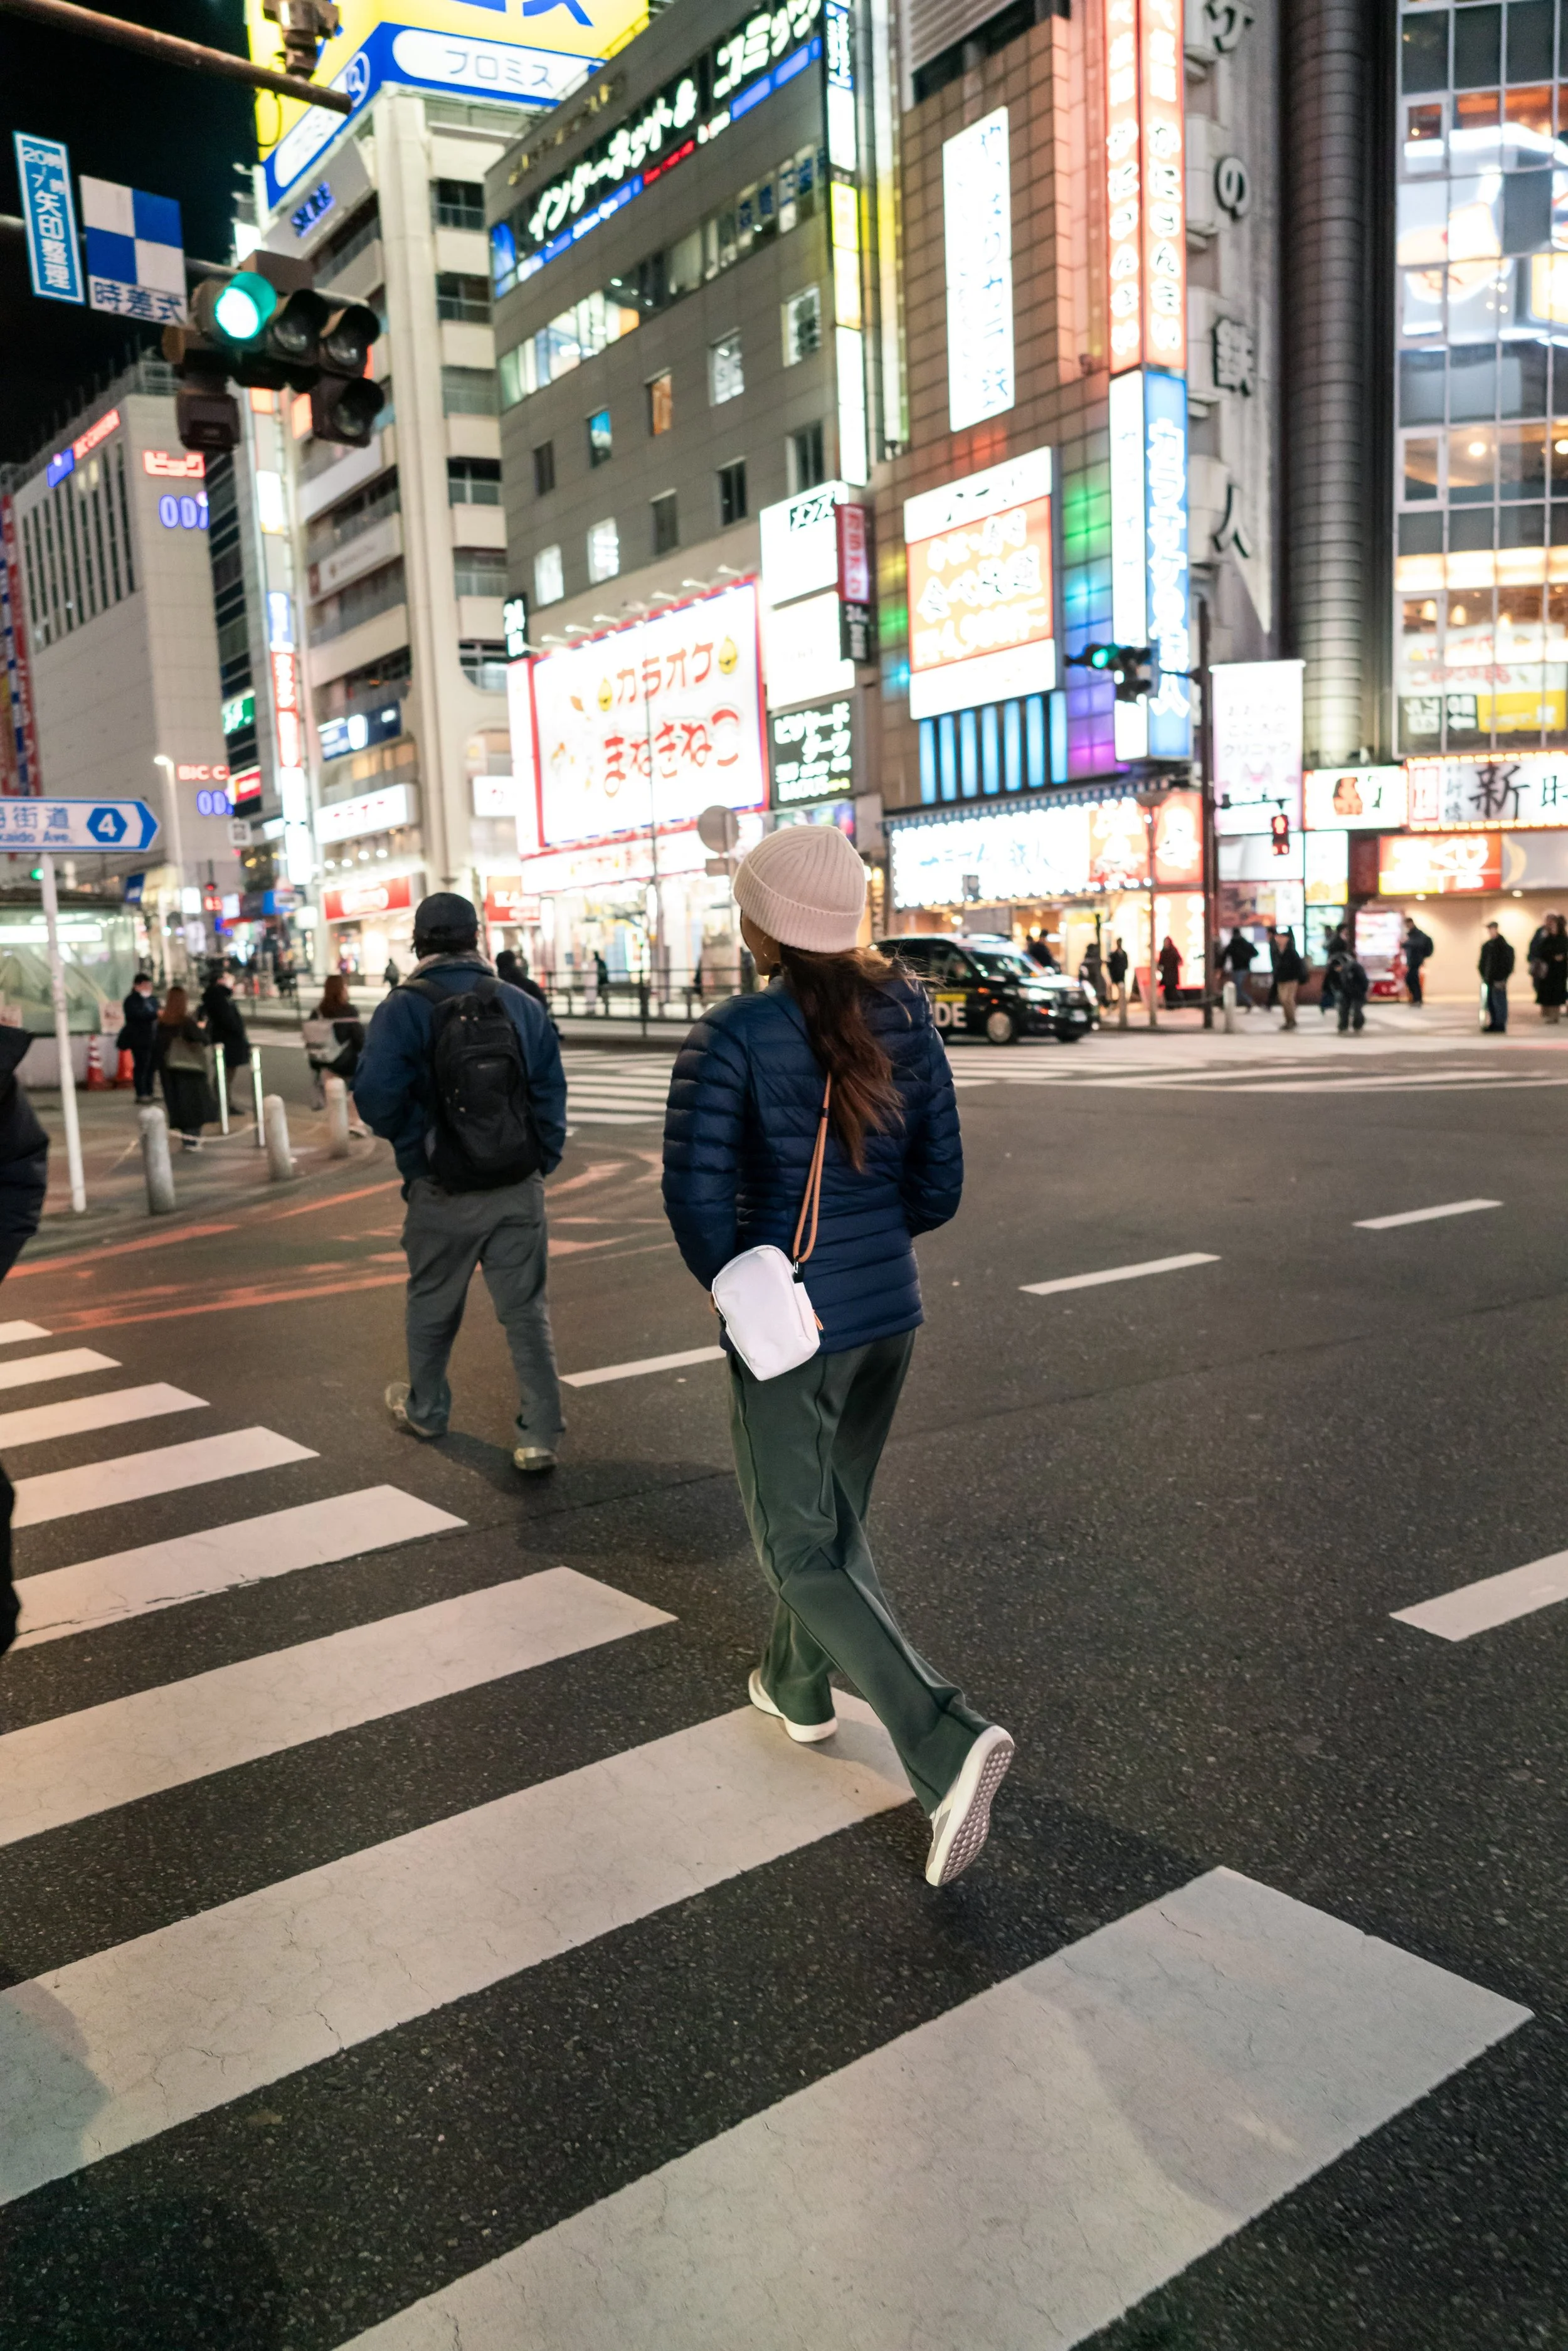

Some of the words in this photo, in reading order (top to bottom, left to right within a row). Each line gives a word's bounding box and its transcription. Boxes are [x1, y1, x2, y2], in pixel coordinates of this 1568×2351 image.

[445, 48, 555, 89] プロミス
[94, 282, 188, 326] 時差式
[617, 641, 714, 706] カラオケ
[176, 763, 210, 781] BIC
[603, 708, 740, 799] まねきねこ
[97, 813, 117, 837] 4
